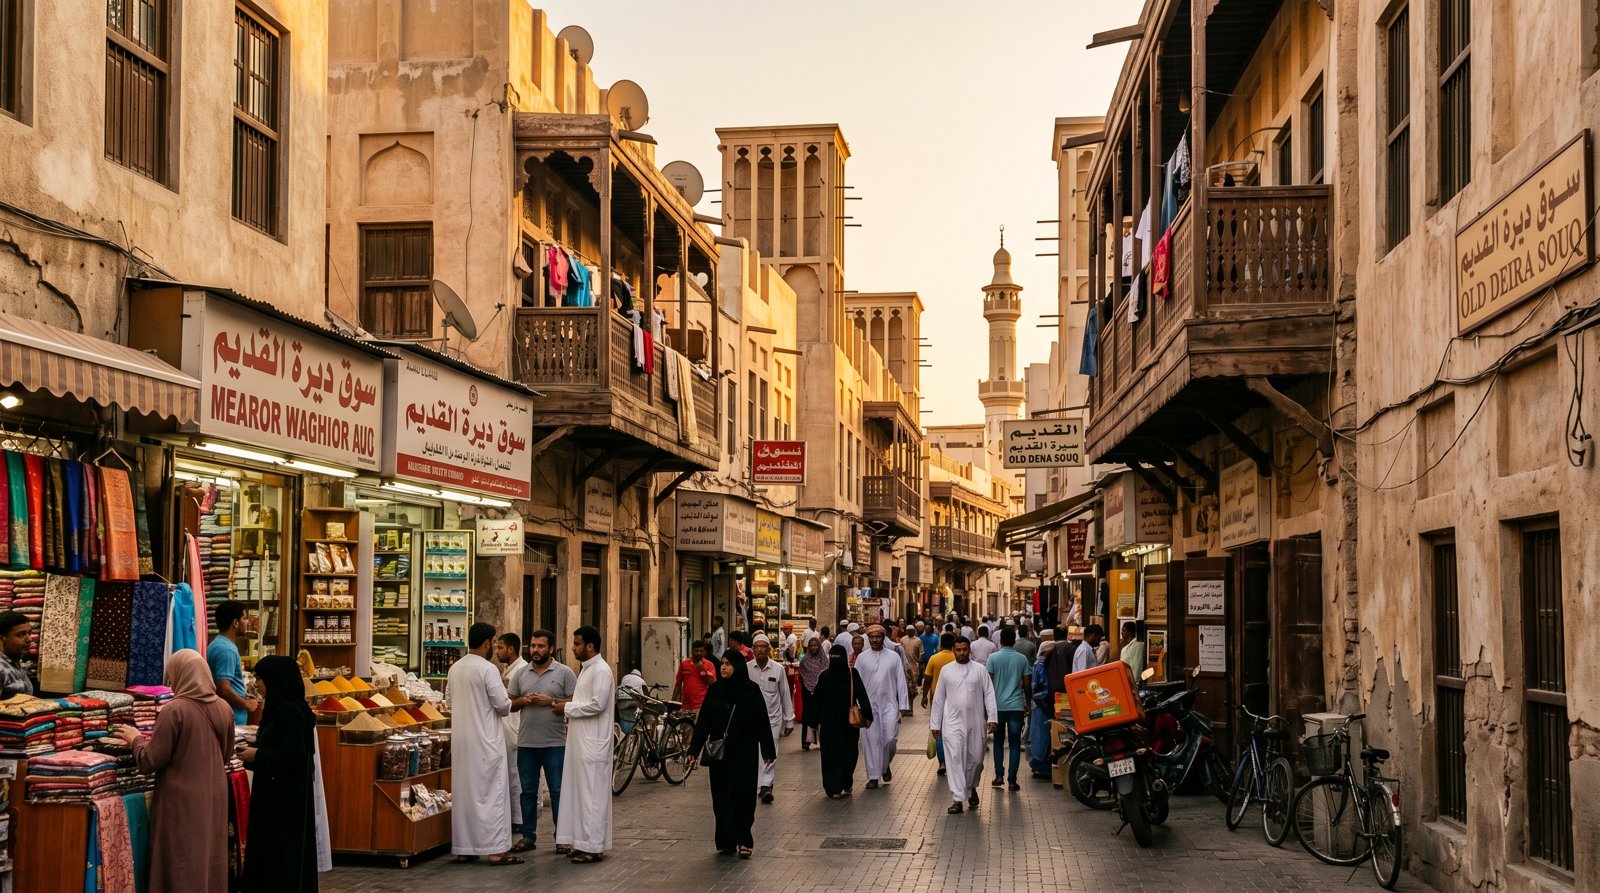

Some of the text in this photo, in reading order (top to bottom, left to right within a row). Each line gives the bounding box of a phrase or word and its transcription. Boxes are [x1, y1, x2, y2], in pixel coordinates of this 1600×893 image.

[1461, 168, 1581, 286] سوق ديرة القديم
[1461, 218, 1585, 319] OLD DEIRA SOUQ
[213, 327, 376, 412] سوق ديرة القديم
[211, 384, 282, 435] MEAROR
[286, 405, 349, 451] WAGHIOR
[405, 400, 526, 456] سوق ديرة القديم
[1009, 442, 1047, 453] القديم
[1011, 424, 1077, 440] القديم
[1009, 453, 1079, 464] OLD DENA SOUQ
